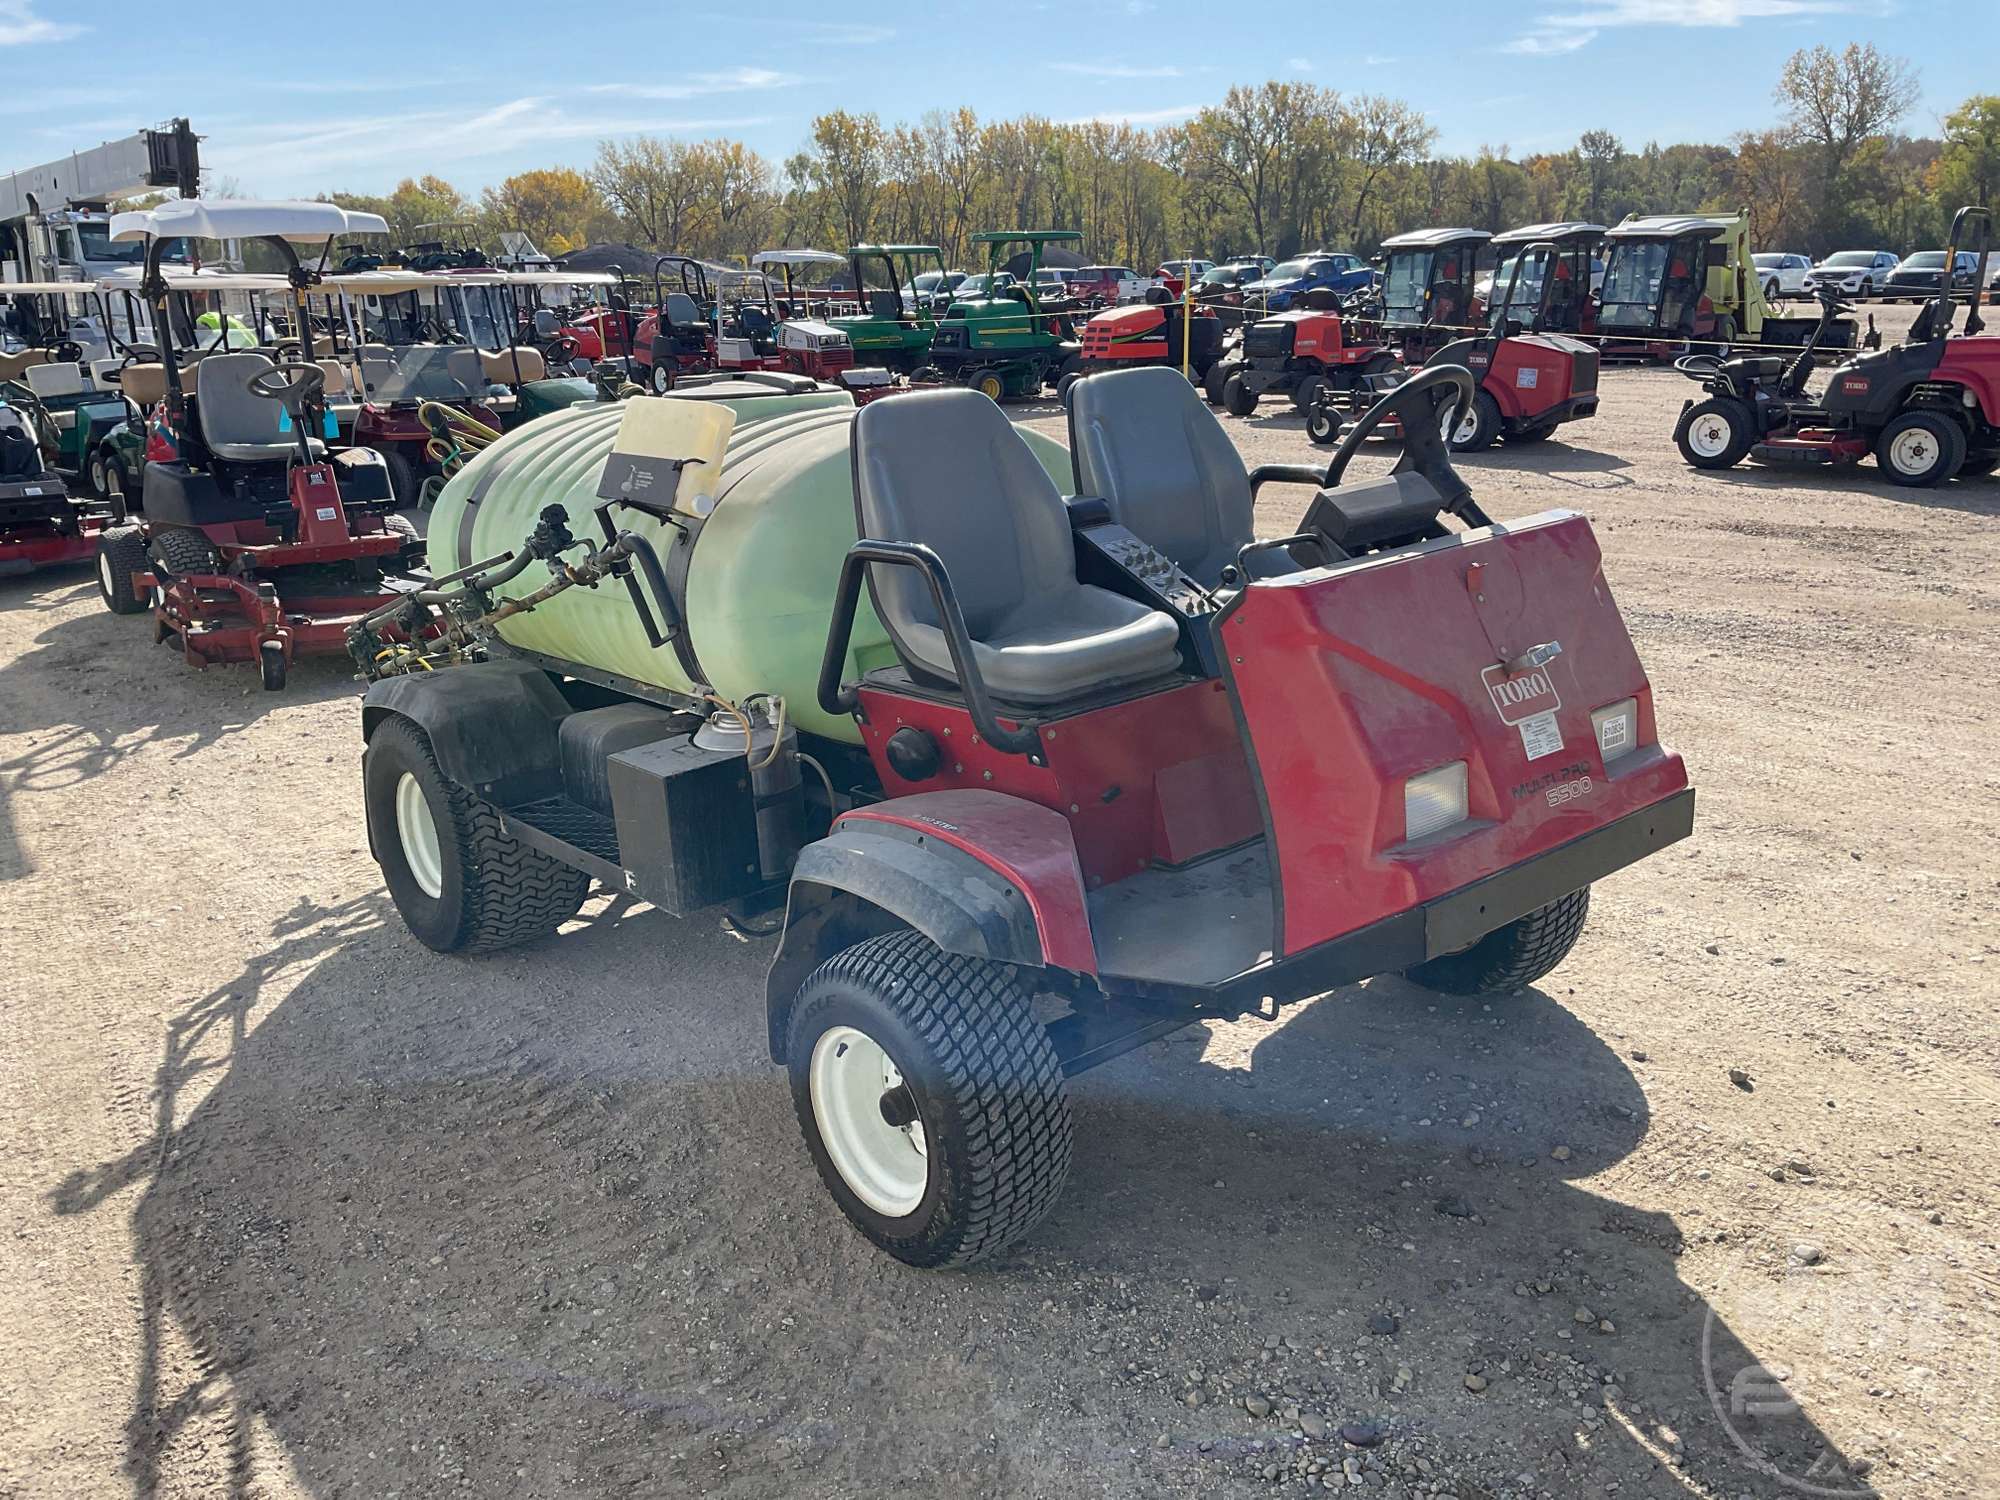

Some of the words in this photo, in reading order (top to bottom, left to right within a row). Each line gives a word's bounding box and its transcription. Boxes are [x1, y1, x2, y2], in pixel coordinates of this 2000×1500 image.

[1845, 382, 1868, 390] TORO
[1493, 673, 1547, 706] TORO
[1545, 775, 1593, 807] 5500
